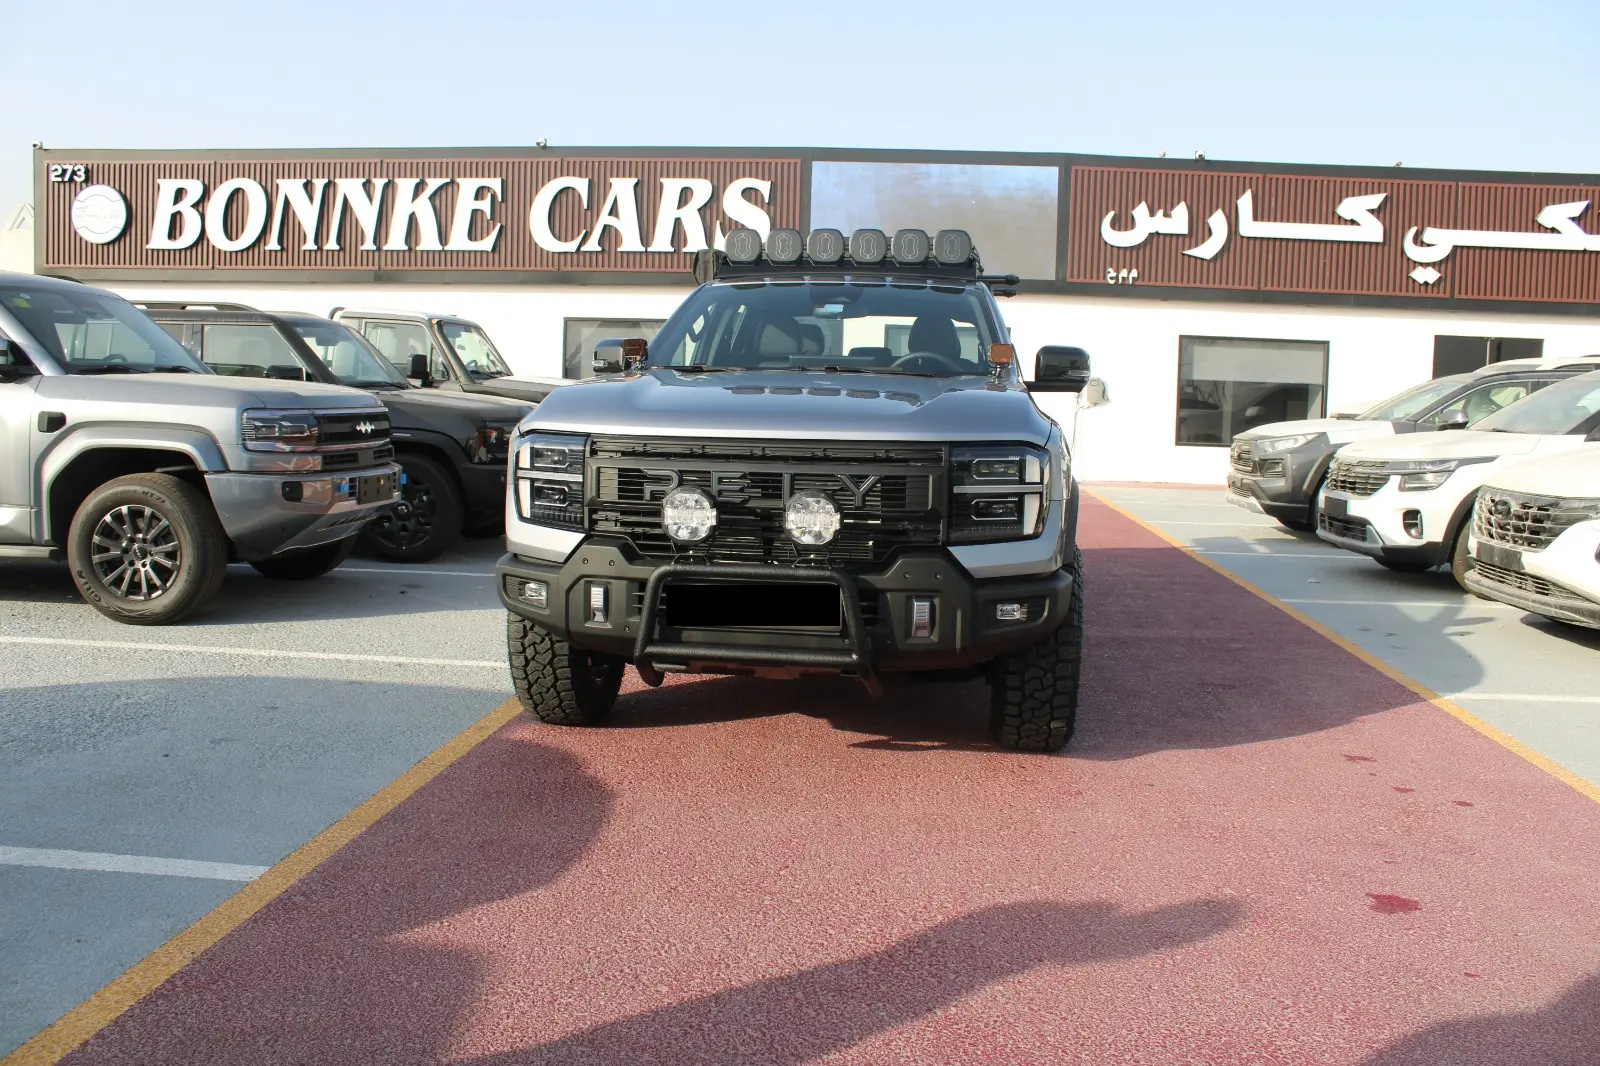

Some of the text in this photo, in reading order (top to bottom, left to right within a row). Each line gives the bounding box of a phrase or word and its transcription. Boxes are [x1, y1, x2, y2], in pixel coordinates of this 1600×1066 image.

[50, 164, 86, 182] 273
[145, 176, 772, 253] BONNKE CARS
[1100, 188, 1387, 260] كارس
